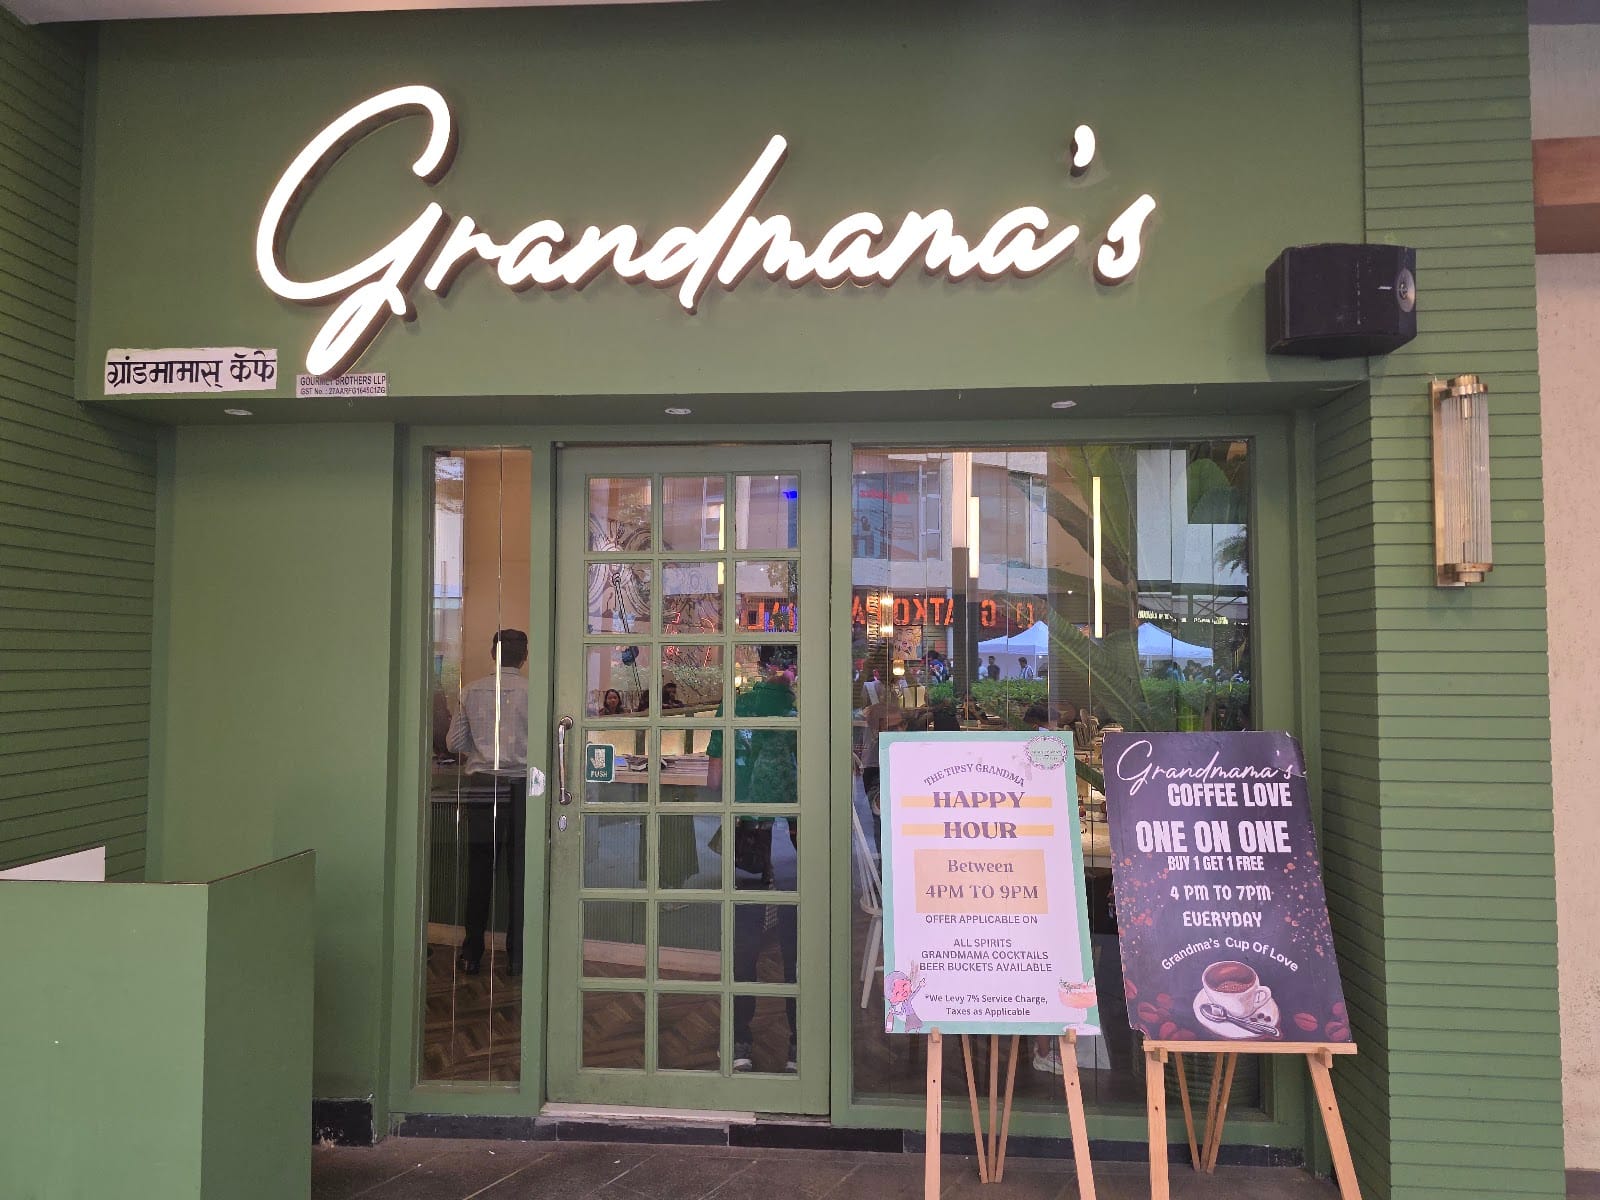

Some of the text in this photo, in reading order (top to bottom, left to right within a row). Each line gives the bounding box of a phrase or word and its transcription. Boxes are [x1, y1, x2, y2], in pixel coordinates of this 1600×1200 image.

[256, 85, 1157, 377] Grandmama's
[230, 350, 276, 382] कॅफे
[335, 375, 372, 386] BROTHERS
[373, 375, 386, 385] LLP
[300, 387, 312, 395] GST
[590, 770, 608, 778] PUSH
[924, 763, 1025, 787] THE TIPSY GRANDMA
[1116, 739, 1293, 796] Grandmama's
[933, 790, 1026, 808] HAPPY
[1167, 782, 1293, 807] COFFEE LOVE
[943, 821, 1018, 839] HOUR
[1135, 820, 1292, 853] ONE ON ONE
[948, 859, 1014, 873] Between
[1167, 855, 1265, 871] BUY 1 GET 1 FREE
[925, 884, 1039, 900] 4PM TO 9PM
[1170, 885, 1180, 900] 4
[1212, 885, 1232, 900] TO
[925, 914, 1038, 924] OFFER APPLICABLE ON
[1182, 910, 1262, 928] EVERYDAY
[953, 938, 1012, 948] ALL SPIRITS
[921, 950, 1049, 960] GRANDMAMA COCKTAILS
[1161, 936, 1299, 972] Grandma's Cup Of Love
[919, 962, 1052, 972] BEER BUCKETS AVAILABLE
[945, 995, 965, 1004] Levy
[966, 994, 980, 1003] 7%
[981, 994, 1013, 1003] Service
[1015, 995, 1048, 1005] Charge,
[946, 1007, 971, 1016] Taxes
[984, 1007, 1030, 1018] Applicable
